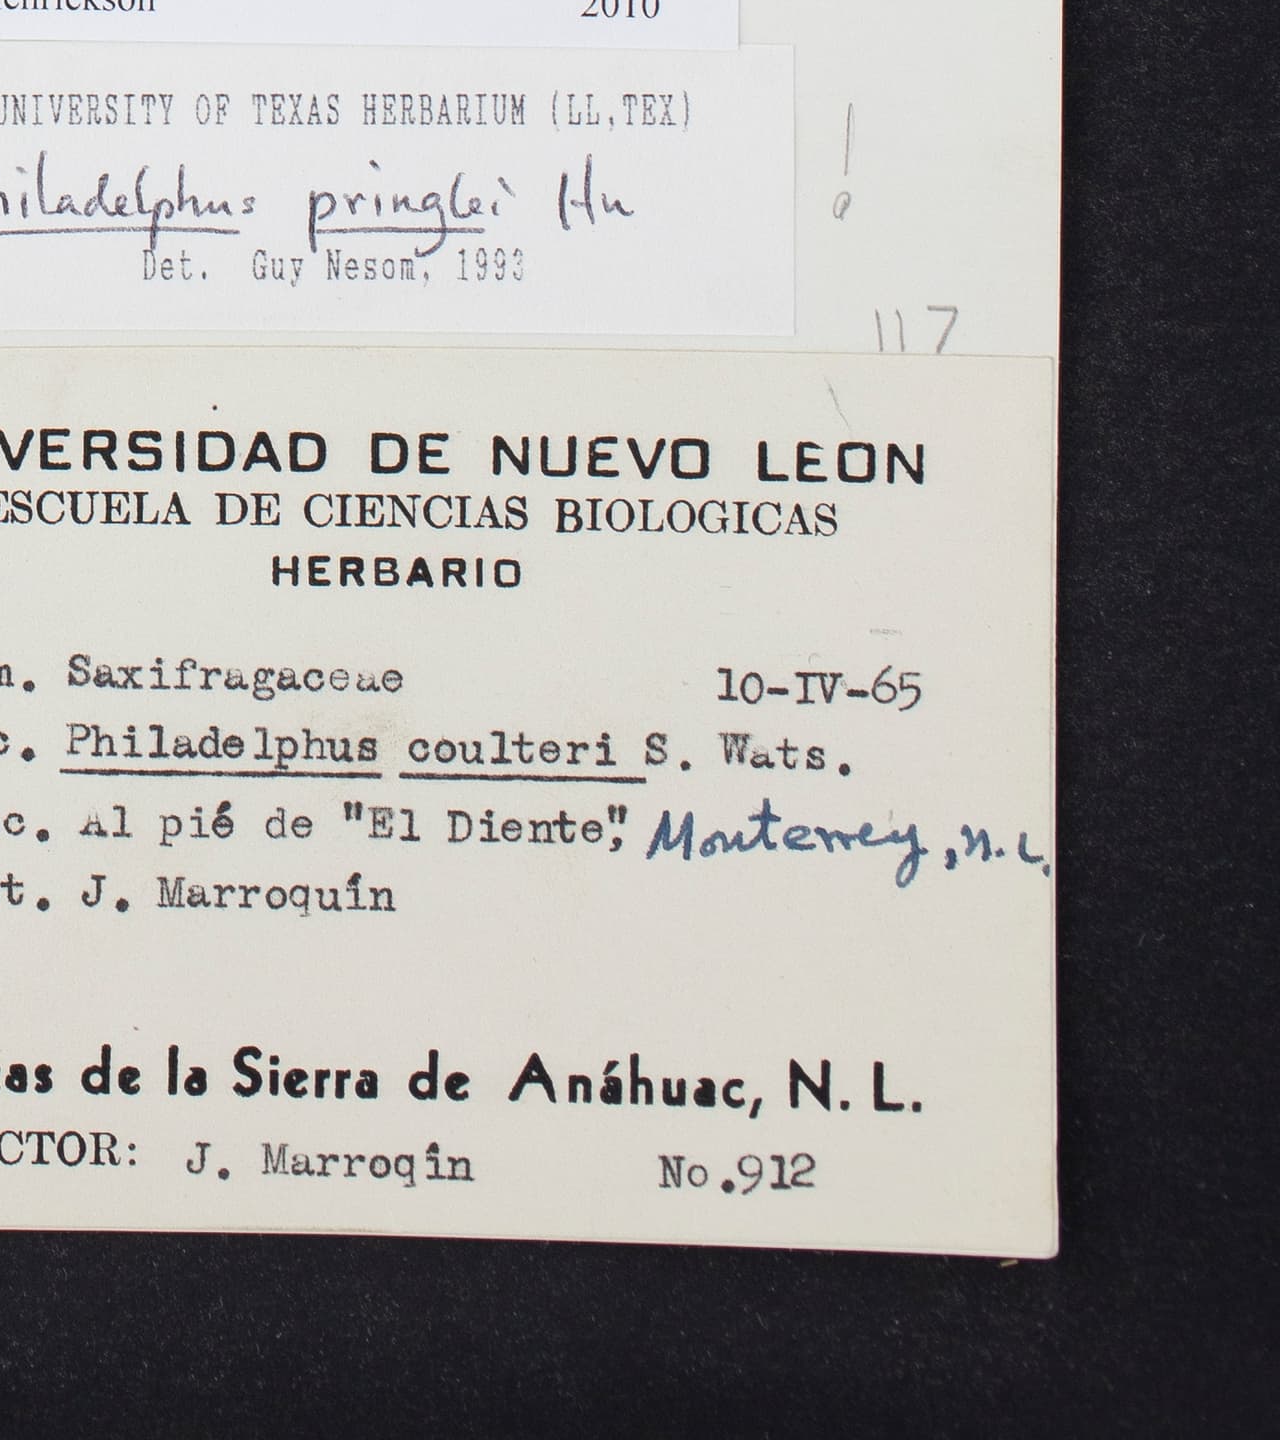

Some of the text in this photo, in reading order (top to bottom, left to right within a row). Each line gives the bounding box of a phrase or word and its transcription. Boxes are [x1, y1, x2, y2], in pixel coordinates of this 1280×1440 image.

[195, 93, 230, 125] OF
[251, 93, 340, 126] TEXAS
[362, 93, 526, 126] HERBARIUM
[552, 91, 689, 127] (LL,TEX)
[308, 160, 515, 257] pringlei
[138, 248, 212, 284] Det.
[252, 249, 304, 288] Guy
[457, 247, 524, 282] 1993
[370, 432, 451, 475] DE
[492, 434, 710, 480] NUEVO
[757, 440, 925, 486] LEON
[214, 492, 281, 527] DE
[303, 493, 529, 531] CIENCIAS
[555, 497, 838, 537] BIOLOGICAS
[271, 555, 522, 589] HERBARIO
[67, 653, 404, 702] Saxifragaceae
[717, 664, 922, 712] 10-IV-65
[66, 723, 378, 769] Philadelphus
[408, 730, 617, 767] coulteri
[644, 731, 692, 772] S.
[718, 732, 851, 777] Wats.
[159, 800, 235, 848] pié
[265, 806, 314, 840] de
[81, 873, 130, 913] J.
[80, 1043, 141, 1096] de
[167, 1044, 208, 1097] la
[232, 1045, 379, 1100] Sierra
[408, 1048, 471, 1102] de
[507, 1052, 763, 1120] Anáhuac,
[186, 1141, 231, 1181] J.
